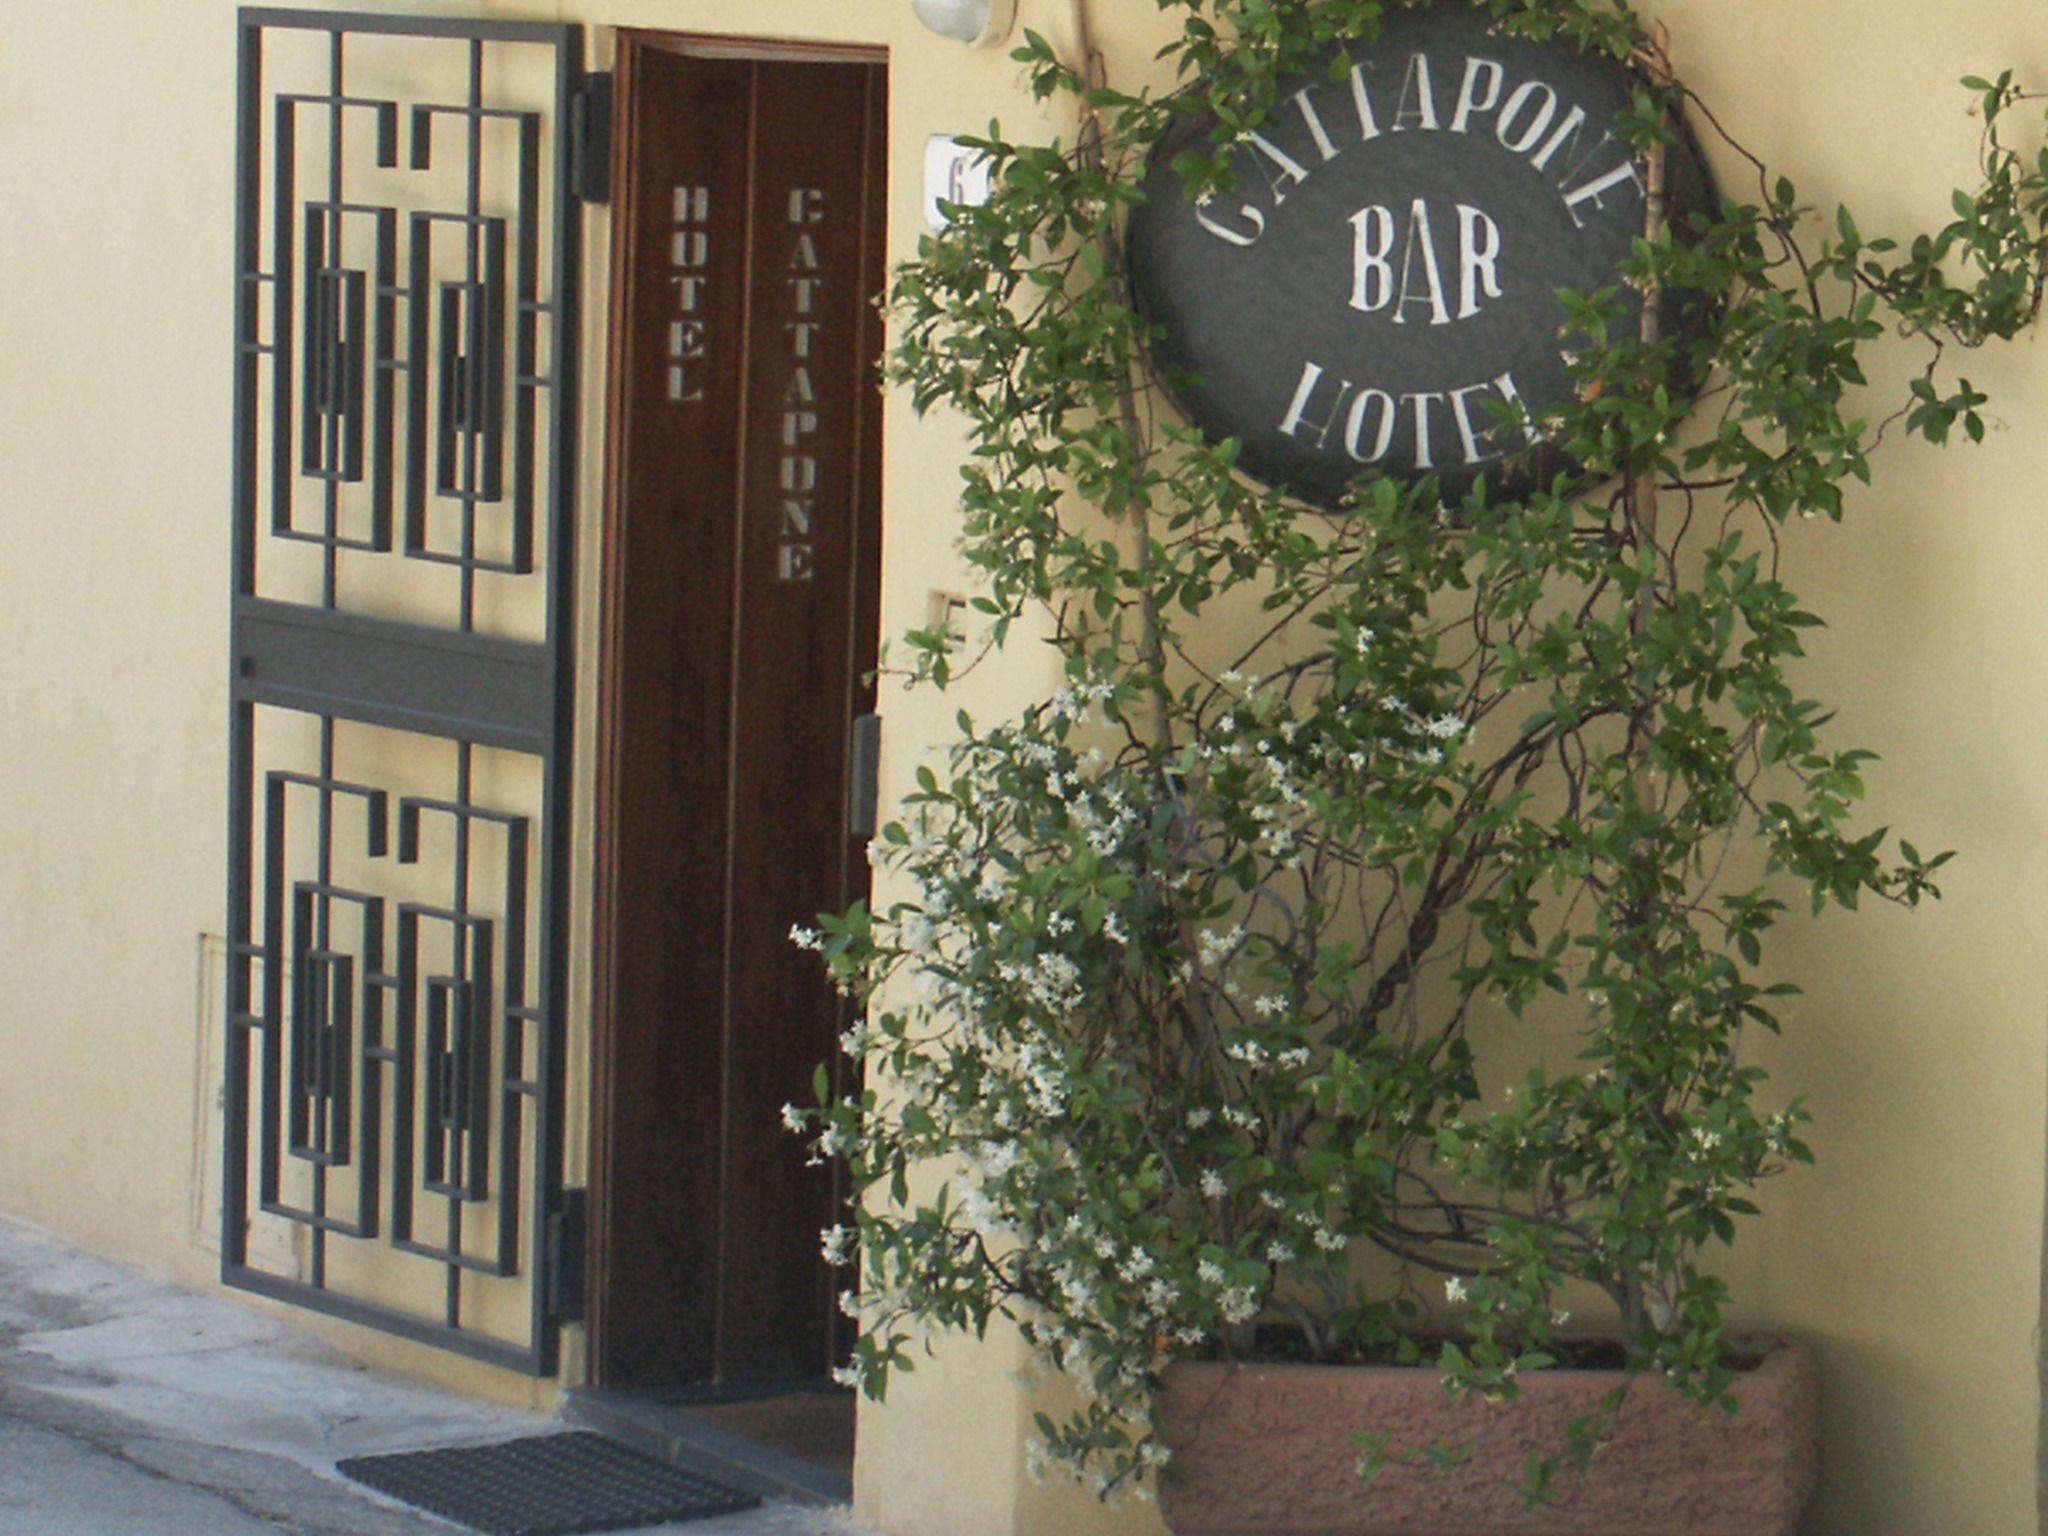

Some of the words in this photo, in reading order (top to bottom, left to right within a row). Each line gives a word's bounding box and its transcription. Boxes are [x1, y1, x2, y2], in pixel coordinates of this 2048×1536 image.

[1195, 52, 1646, 247] CATTAPONE
[667, 186, 709, 401] HOTEL
[1348, 198, 1502, 325] BAR
[778, 188, 824, 580] CATTAPONE
